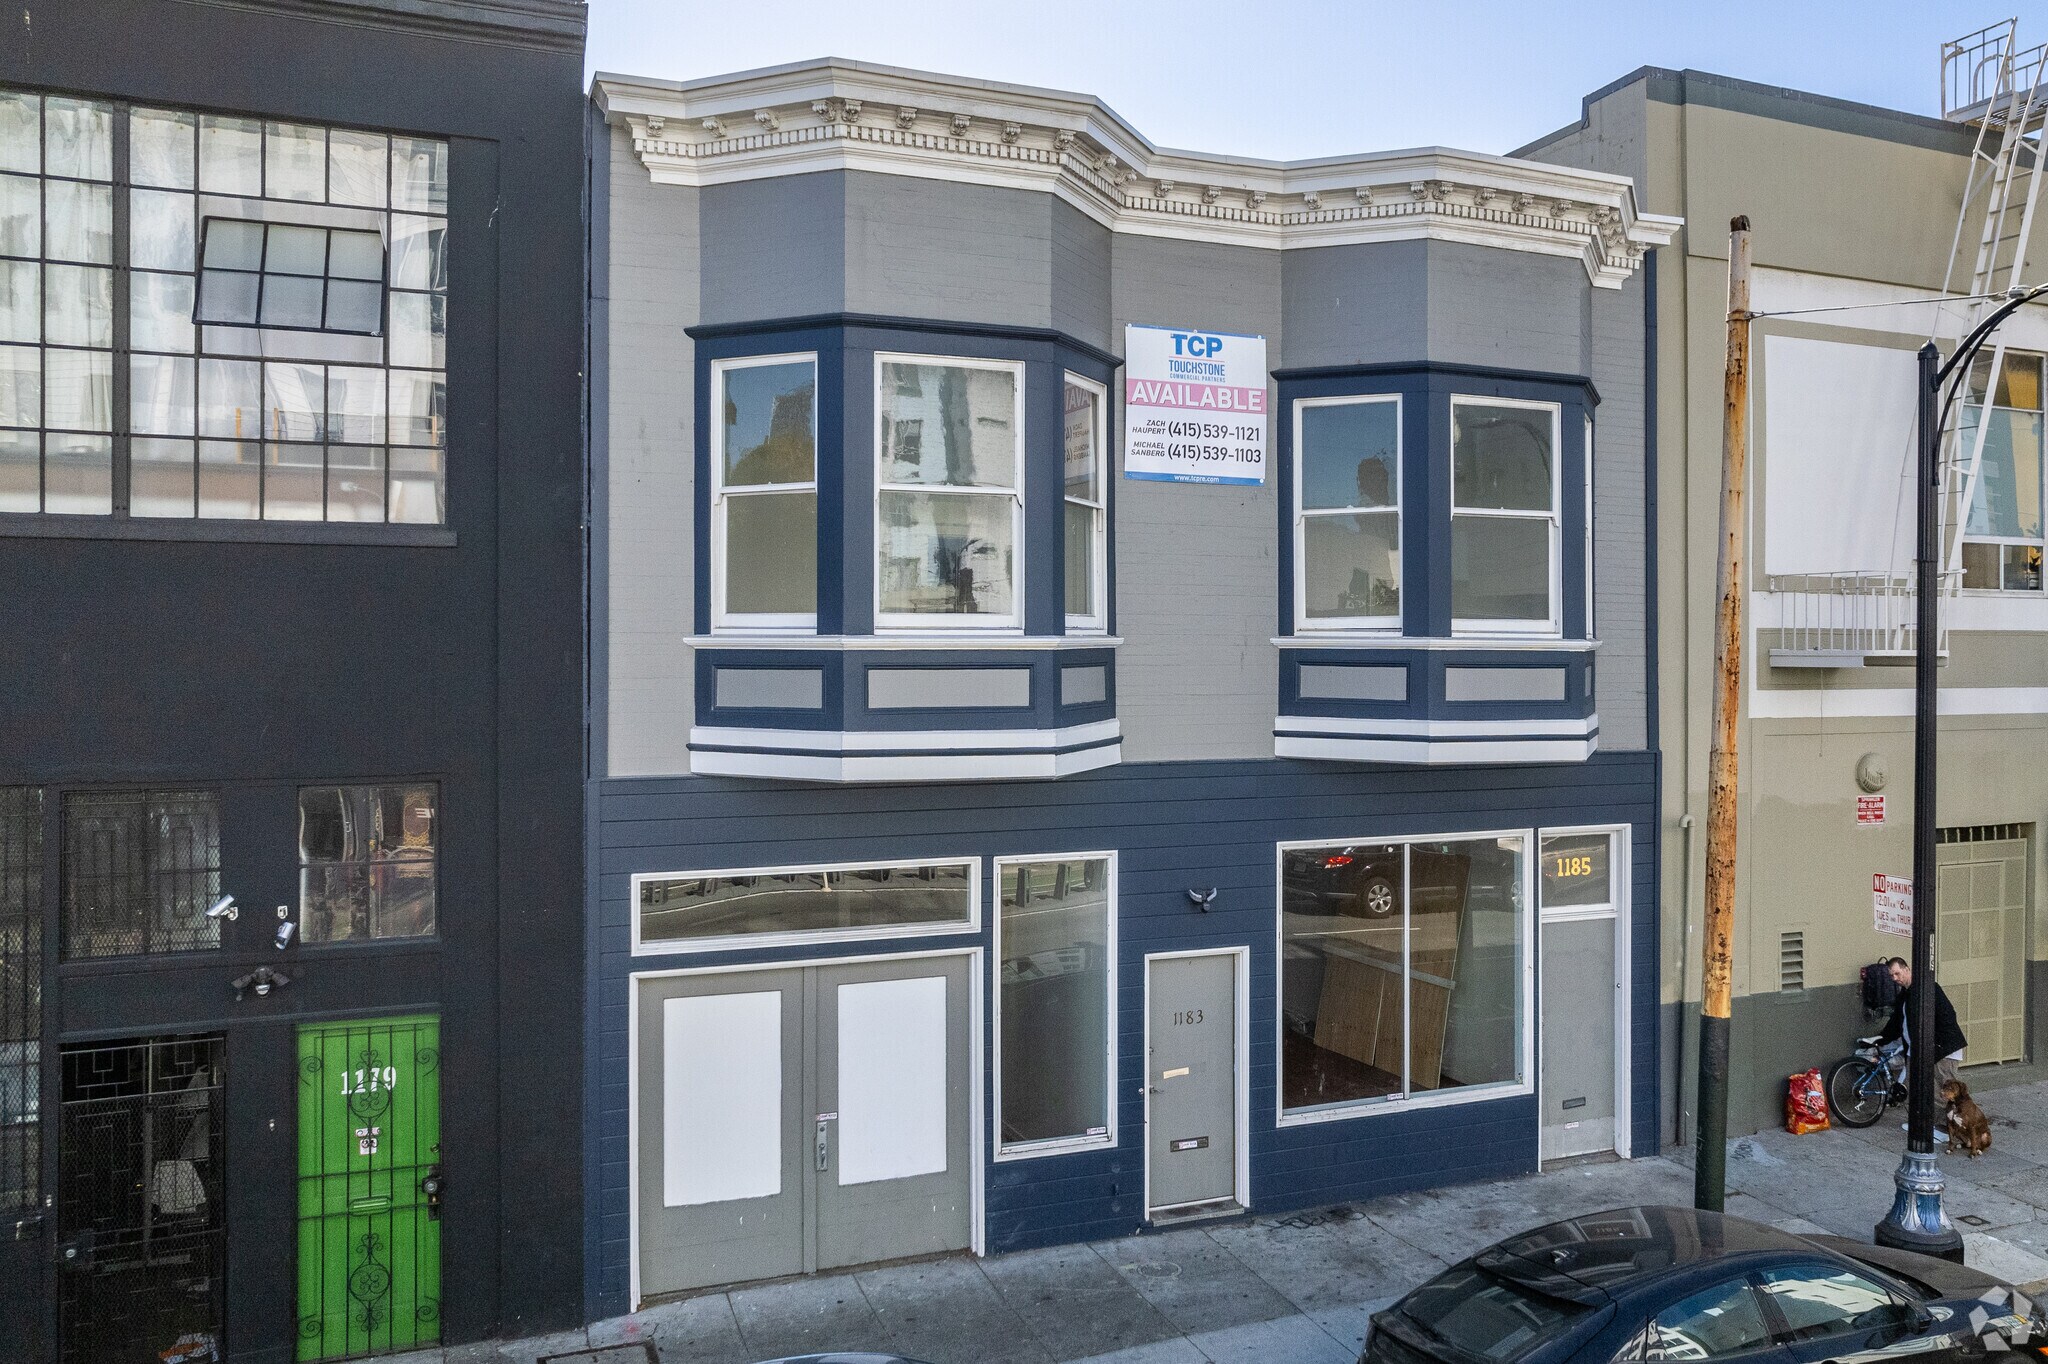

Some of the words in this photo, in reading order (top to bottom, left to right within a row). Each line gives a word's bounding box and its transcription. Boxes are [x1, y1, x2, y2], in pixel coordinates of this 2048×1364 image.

[1170, 334, 1223, 358] TCP
[1169, 360, 1225, 376] TOUCHSTONE
[1170, 373, 1200, 381] COMMERCIAL
[1131, 381, 1262, 411] AVAILABLE
[1168, 421, 1201, 439] (415)
[1203, 424, 1260, 441] 539-1121
[1131, 449, 1165, 457] SANBERG
[1133, 441, 1165, 449] MICHAEL
[1168, 443, 1201, 461] (415)
[1203, 446, 1261, 463] 539-1103
[1174, 475, 1220, 483] www.tcpre.com
[1557, 857, 1591, 877] 1185
[1874, 875, 1885, 892] NO
[1887, 881, 1912, 896] PARKING
[1876, 910, 1889, 921] TUES
[1892, 926, 1911, 936] CLEANING
[1174, 1009, 1203, 1026] 1183
[341, 1066, 396, 1095] 1179
